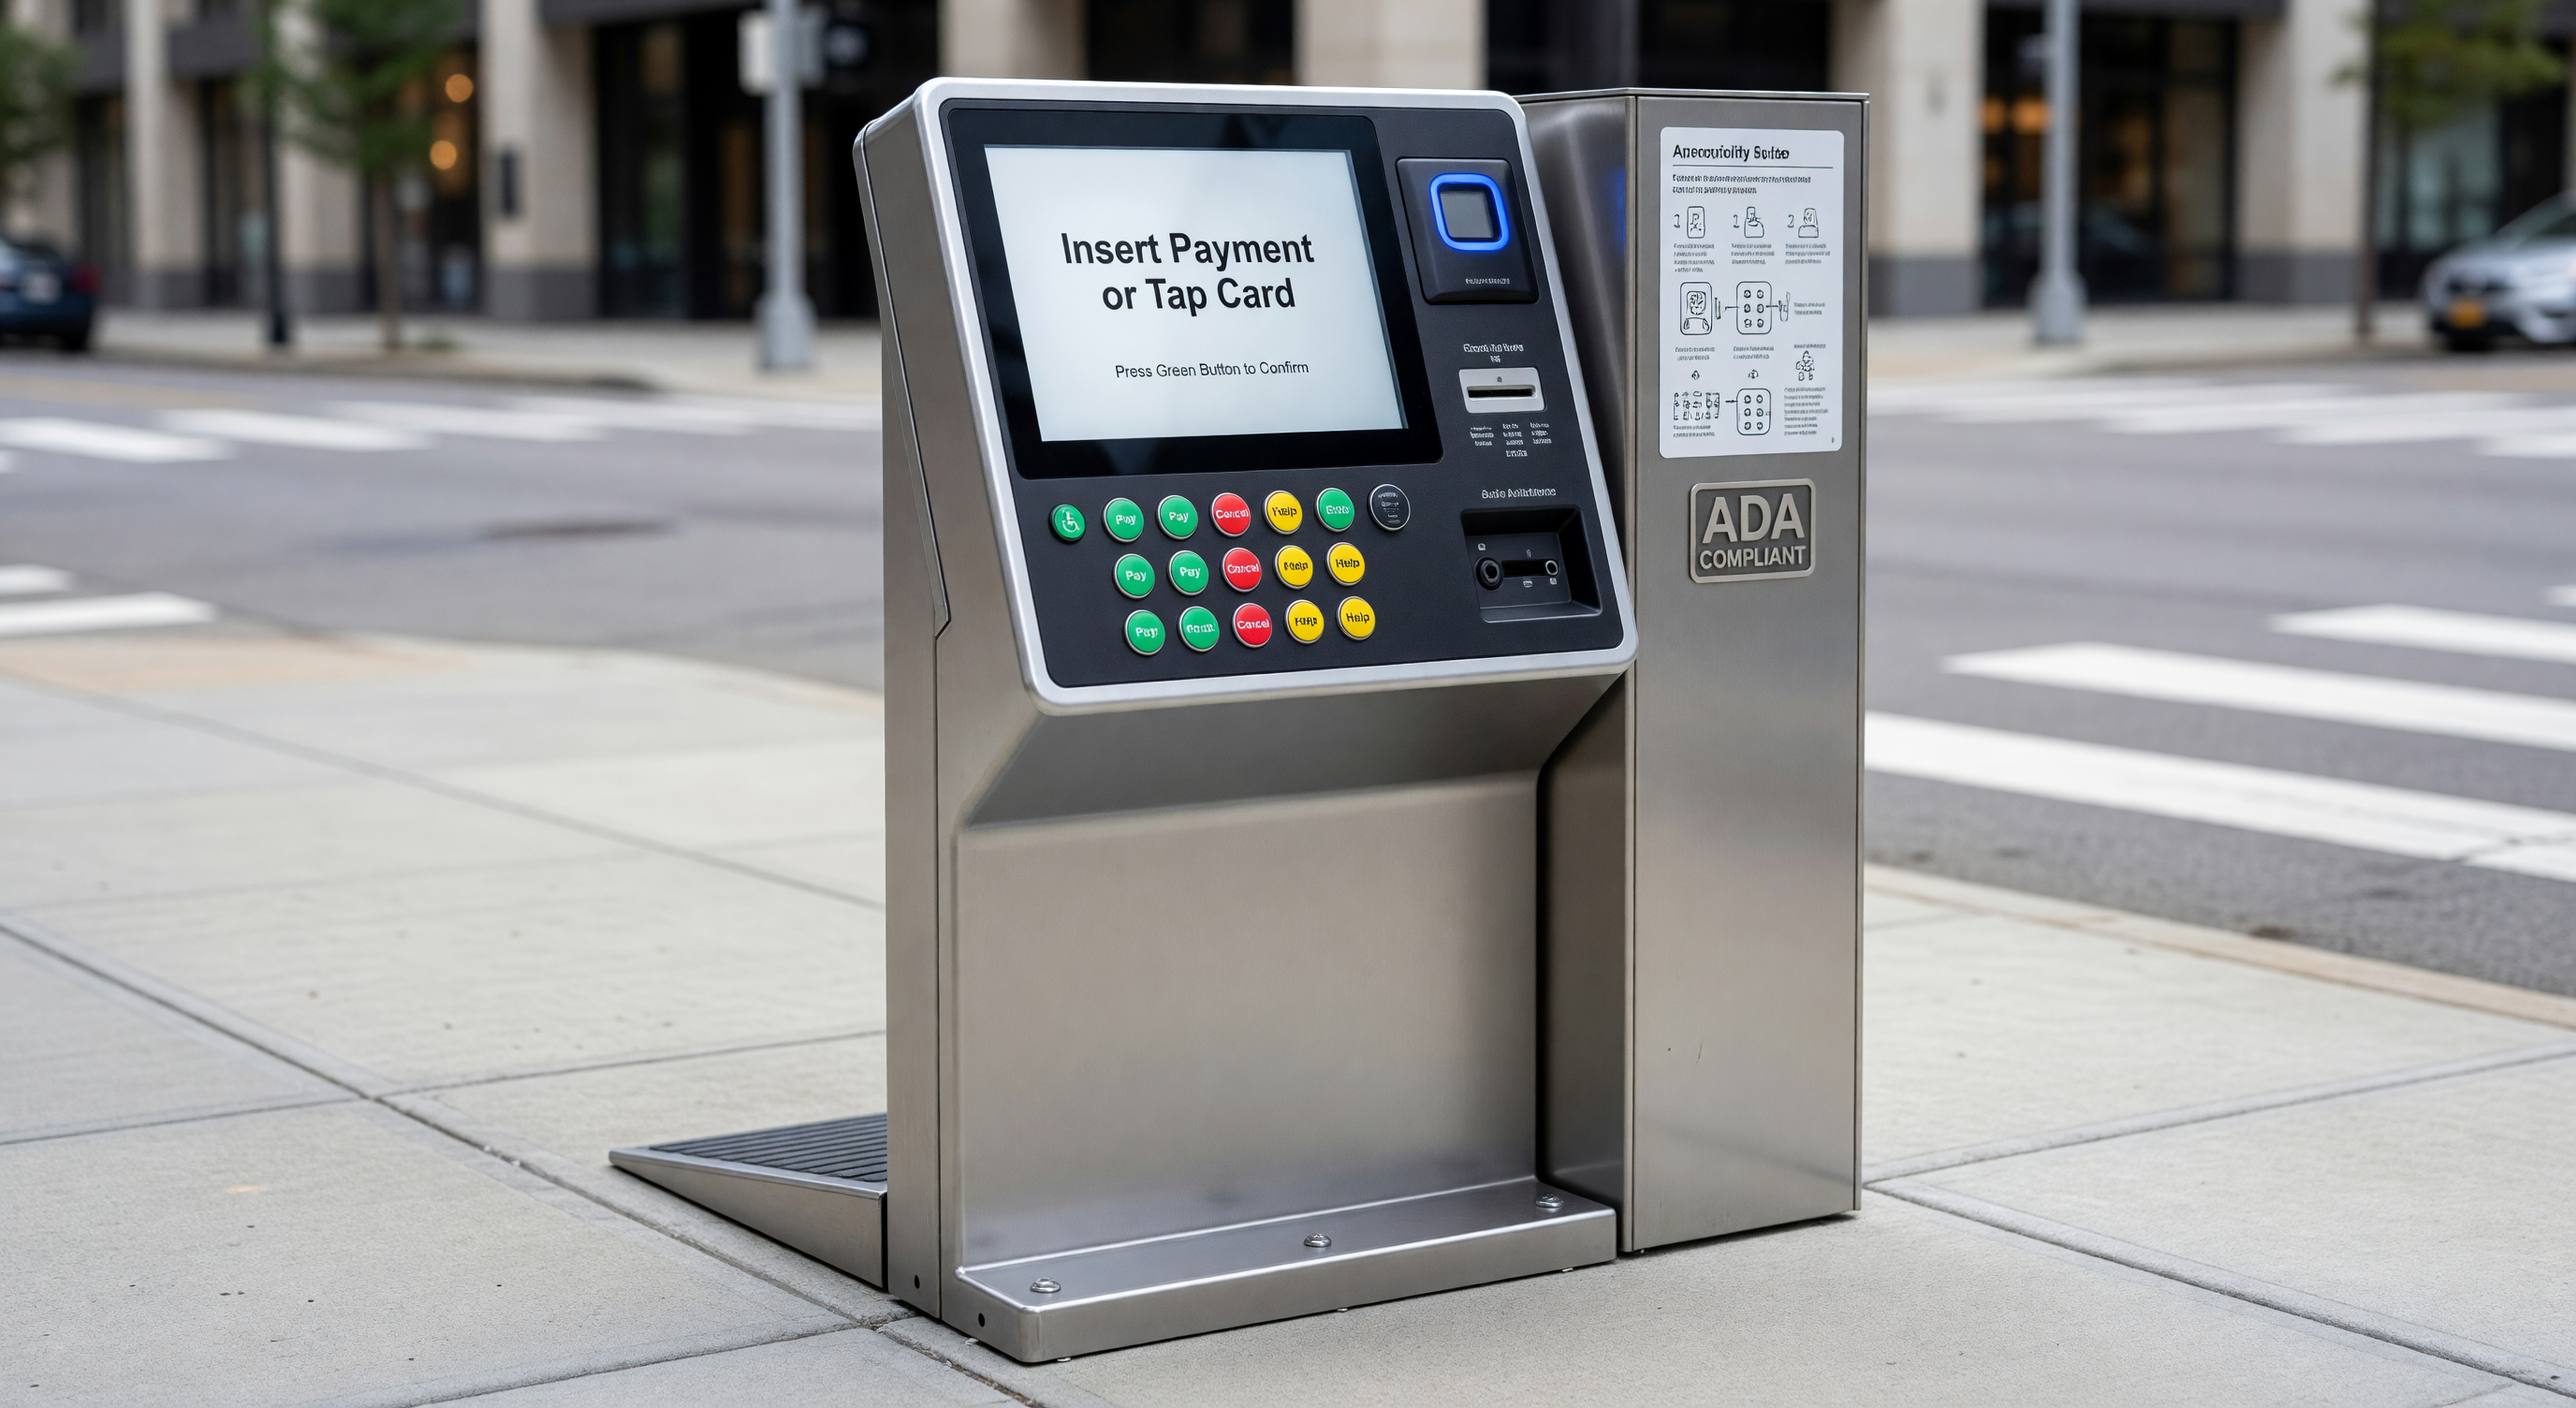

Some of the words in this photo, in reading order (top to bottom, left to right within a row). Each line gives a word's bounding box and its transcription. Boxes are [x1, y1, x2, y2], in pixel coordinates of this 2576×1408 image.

[1061, 232, 1163, 265] Insert
[1168, 232, 1315, 272] Payment
[1102, 286, 1137, 311] or
[1144, 277, 1208, 317] Tap
[1217, 277, 1296, 309] Card
[1115, 364, 1153, 378] Press
[1156, 363, 1197, 377] Green
[1198, 362, 1241, 376] Button
[1243, 362, 1256, 375] to
[1259, 360, 1310, 374] Confirm
[1169, 511, 1189, 523] Pay
[1702, 492, 1806, 544] ADA
[1335, 558, 1360, 569] Help
[1699, 545, 1807, 570] COMPLIANT
[1125, 570, 1147, 582] Pay
[1178, 566, 1201, 579] Pay
[1346, 611, 1370, 624] Help
